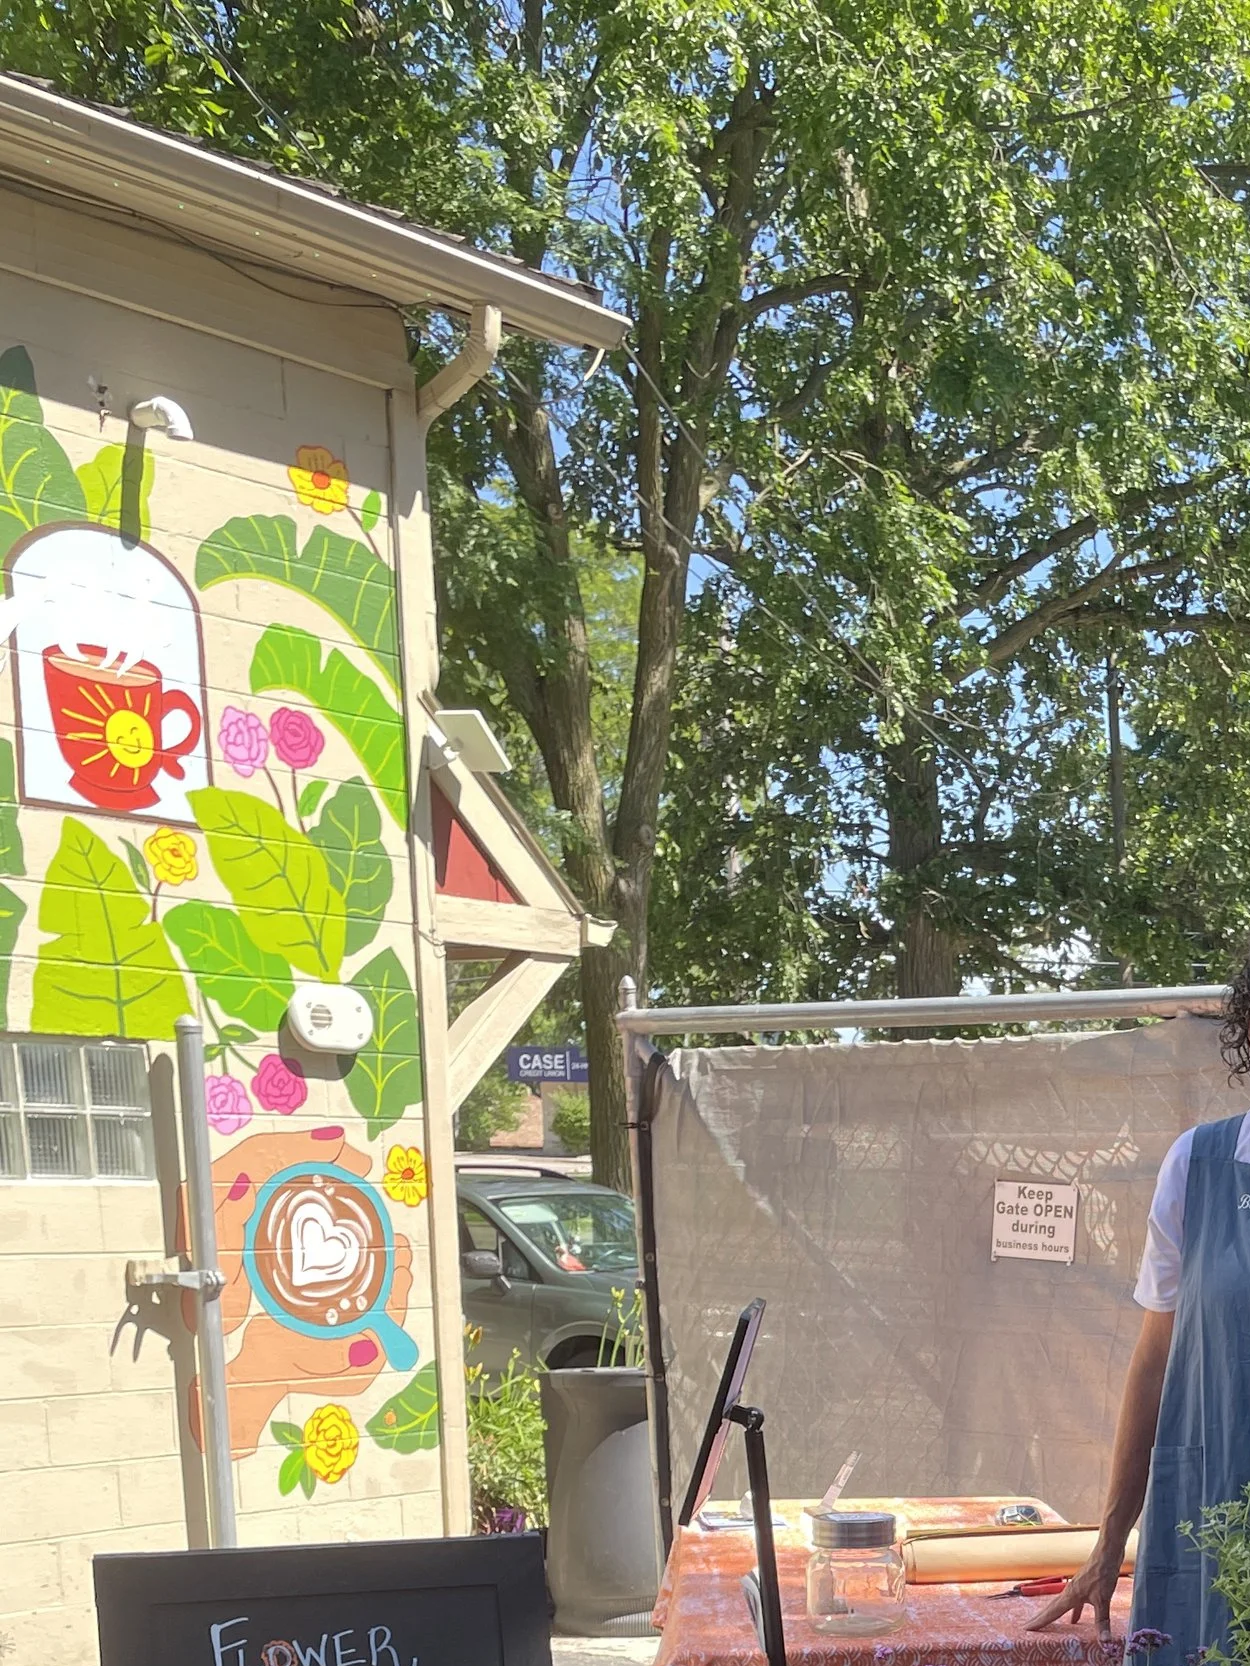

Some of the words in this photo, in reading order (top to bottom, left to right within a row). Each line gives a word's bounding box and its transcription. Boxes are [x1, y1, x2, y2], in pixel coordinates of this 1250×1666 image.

[518, 1053, 565, 1070] CASE
[1017, 1186, 1053, 1204] Keep
[996, 1201, 1029, 1216] Gate
[1033, 1203, 1074, 1219] OPEN
[1011, 1219, 1056, 1239] during
[996, 1238, 1039, 1252] business
[1041, 1242, 1070, 1254] hours
